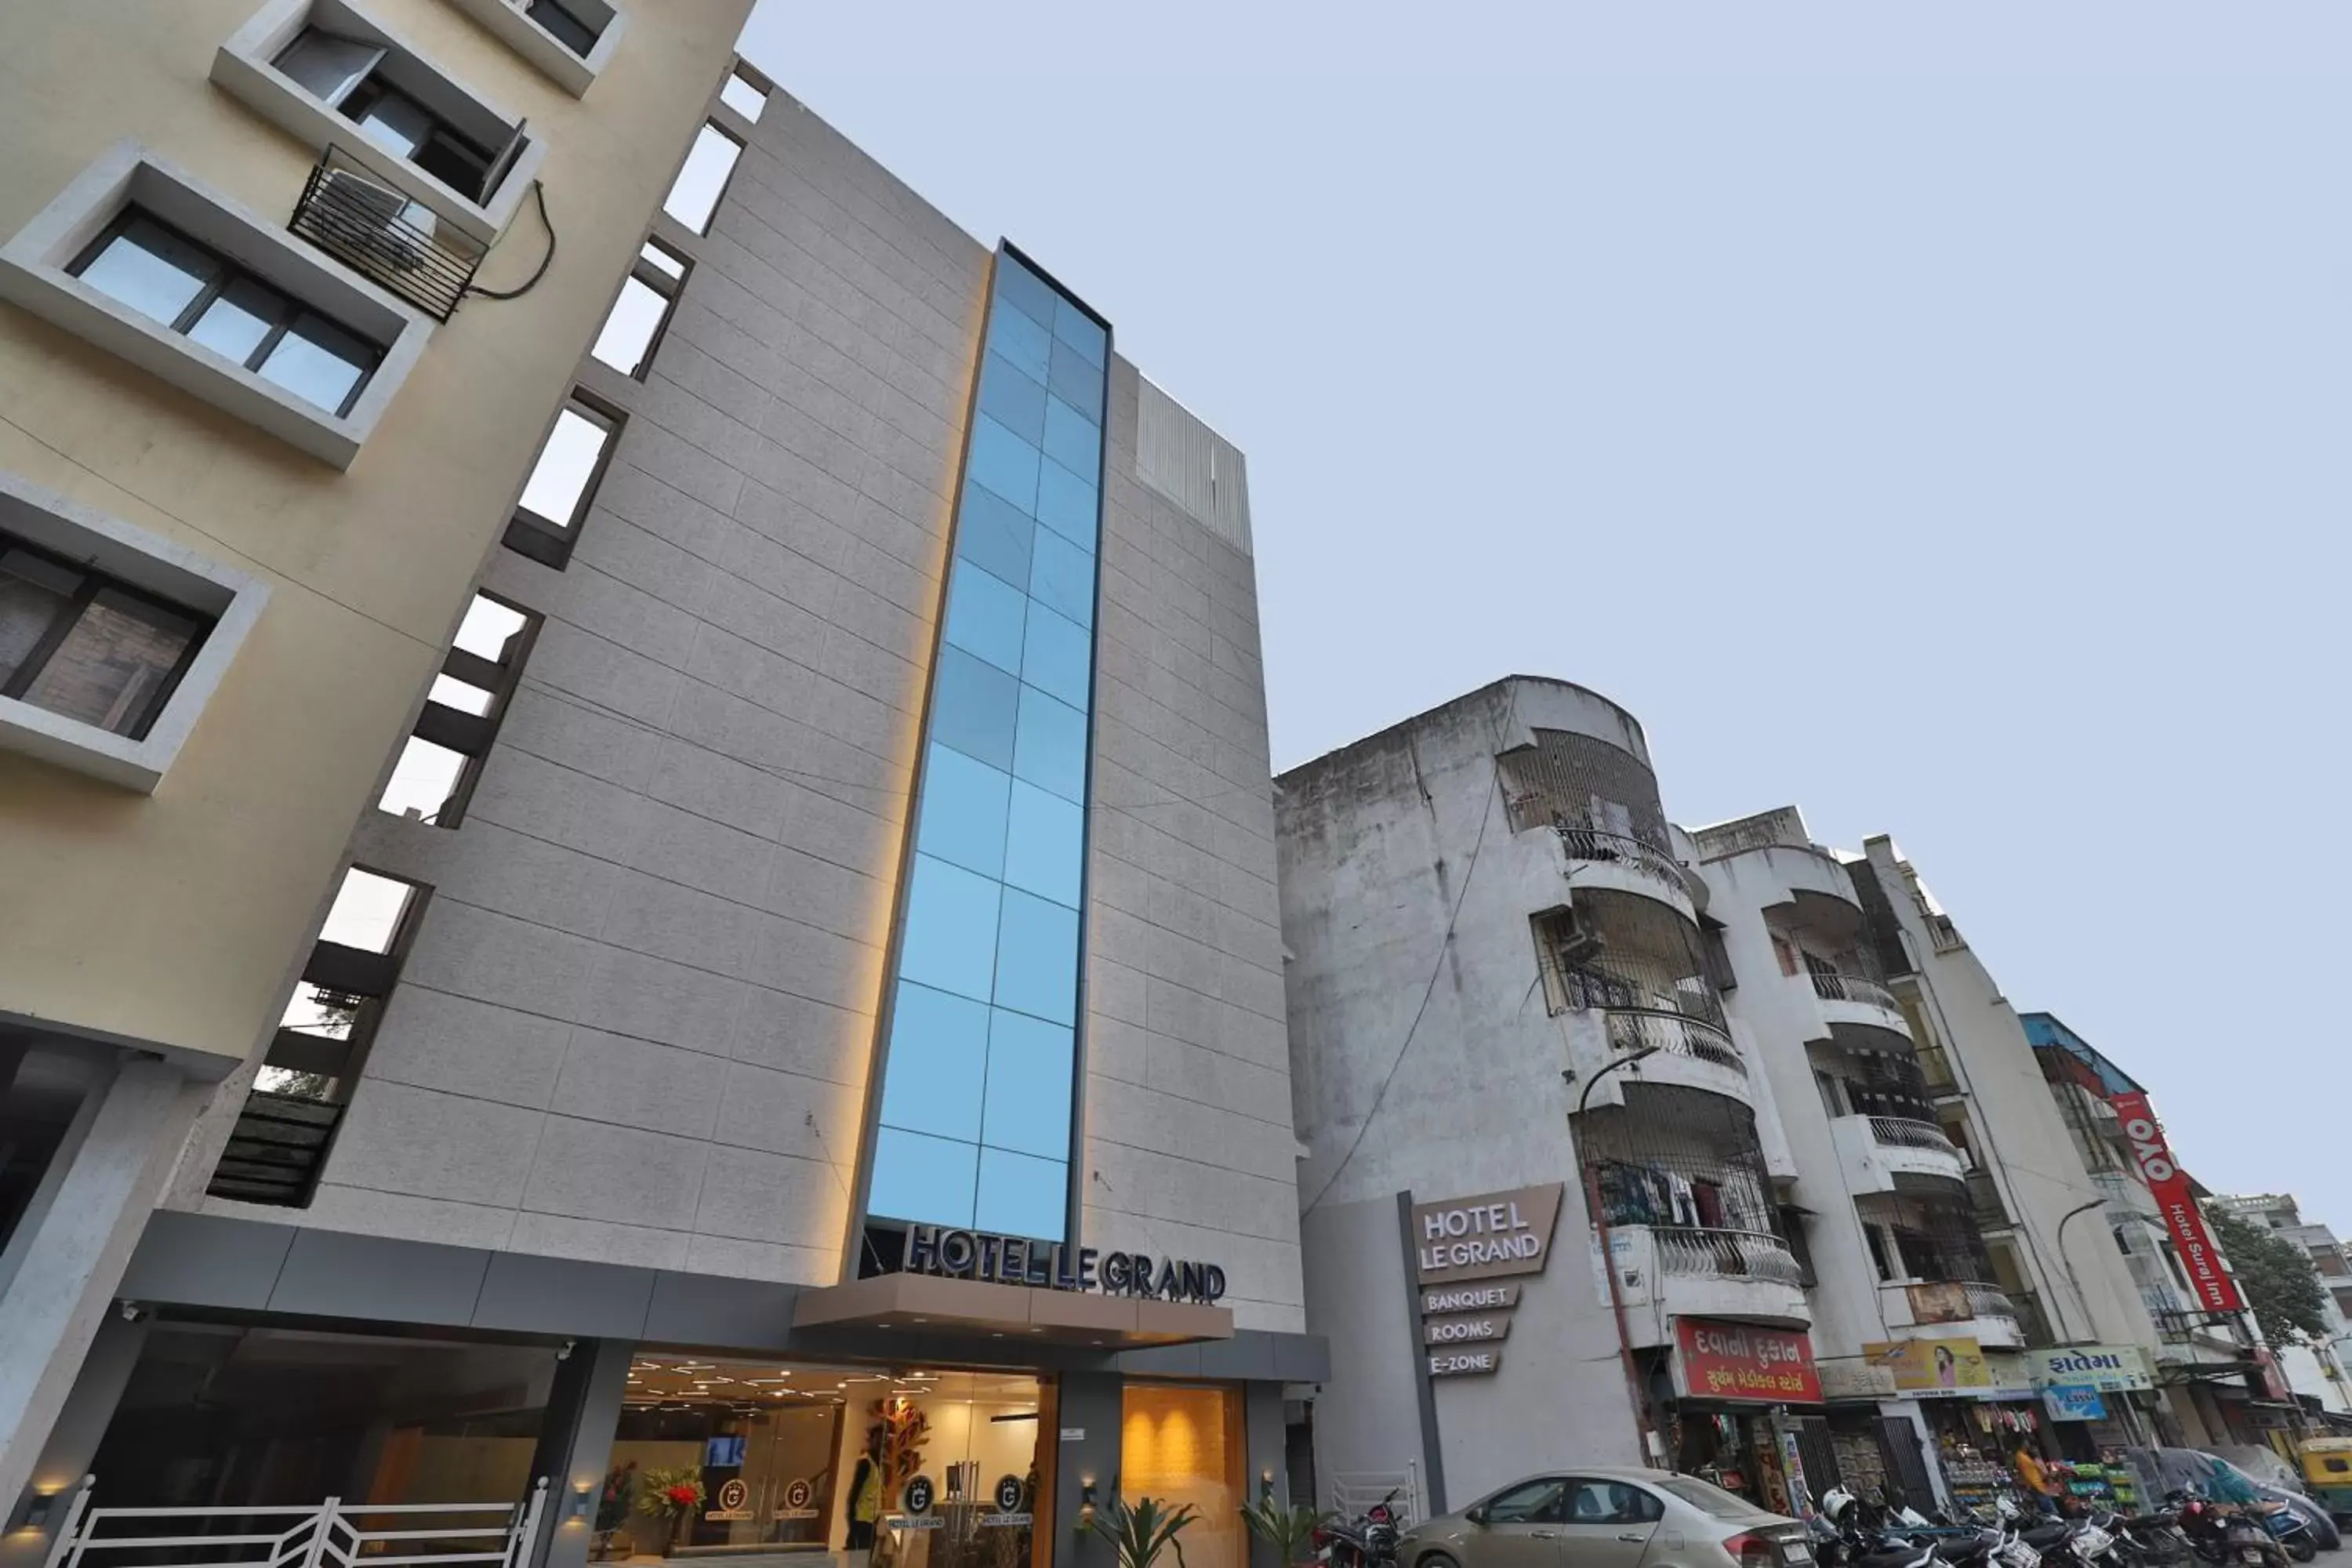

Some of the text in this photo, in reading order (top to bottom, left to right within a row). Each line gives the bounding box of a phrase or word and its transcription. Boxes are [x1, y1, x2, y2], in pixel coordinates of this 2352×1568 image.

[2127, 1119, 2172, 1181] OYO
[1425, 1202, 1530, 1240] HOTEL
[904, 1223, 1225, 1301] HOTEL LE GRAND
[1421, 1234, 1540, 1270] LE GRAND
[2169, 1203, 2224, 1306] Hotel Suraj Inn
[1428, 1288, 1506, 1310] BANQUET
[1432, 1321, 1493, 1341] ROOMS
[1694, 1329, 1802, 1369] દવાની દુકાન
[1431, 1355, 1490, 1373] E-ZONE
